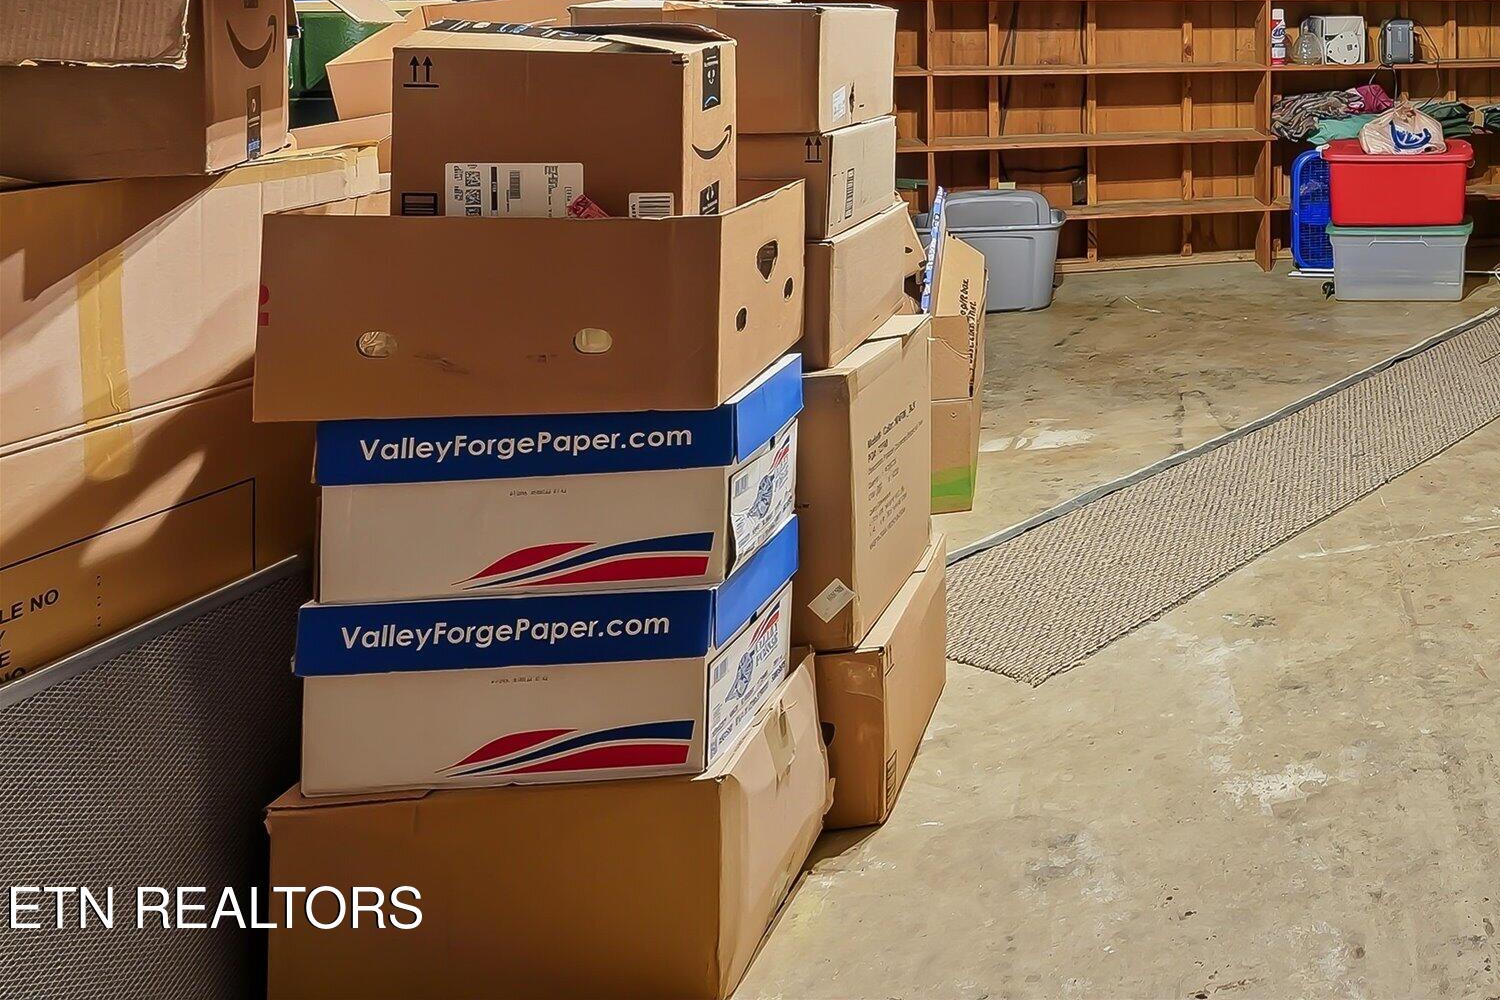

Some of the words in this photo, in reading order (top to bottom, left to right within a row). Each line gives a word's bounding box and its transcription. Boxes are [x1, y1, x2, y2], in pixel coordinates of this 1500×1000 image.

[359, 426, 693, 464] ValleyForgePaper.com
[30, 589, 59, 612] NO
[341, 615, 670, 651] ValleyForgePaper.com
